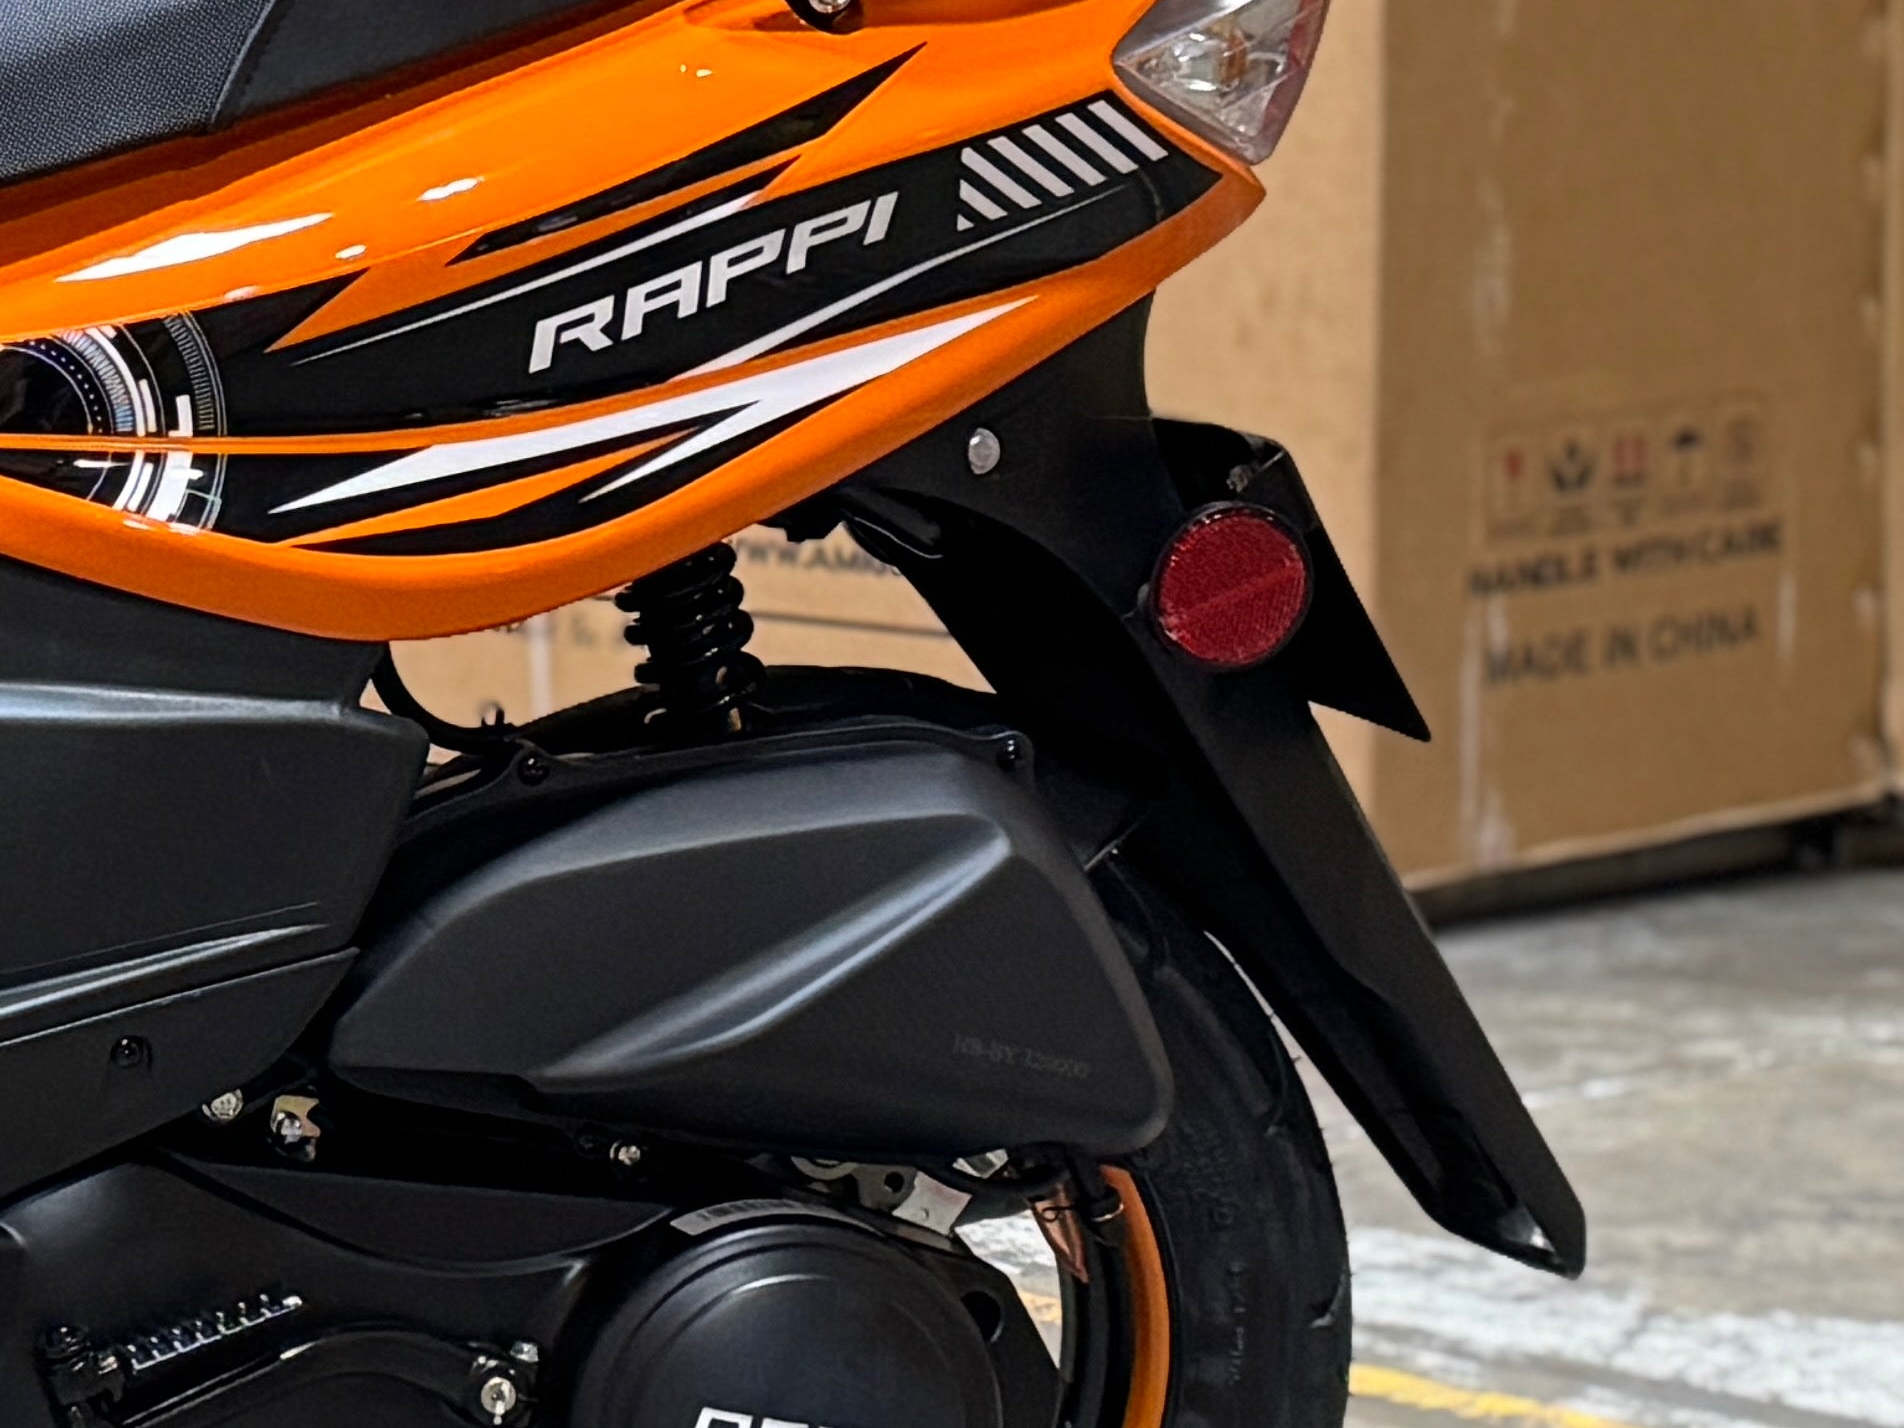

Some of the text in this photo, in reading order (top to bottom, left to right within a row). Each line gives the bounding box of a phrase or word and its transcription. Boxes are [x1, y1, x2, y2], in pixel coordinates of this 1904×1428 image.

[527, 190, 899, 374] RAPPI
[1486, 607, 1760, 684] MADE IN CHINA
